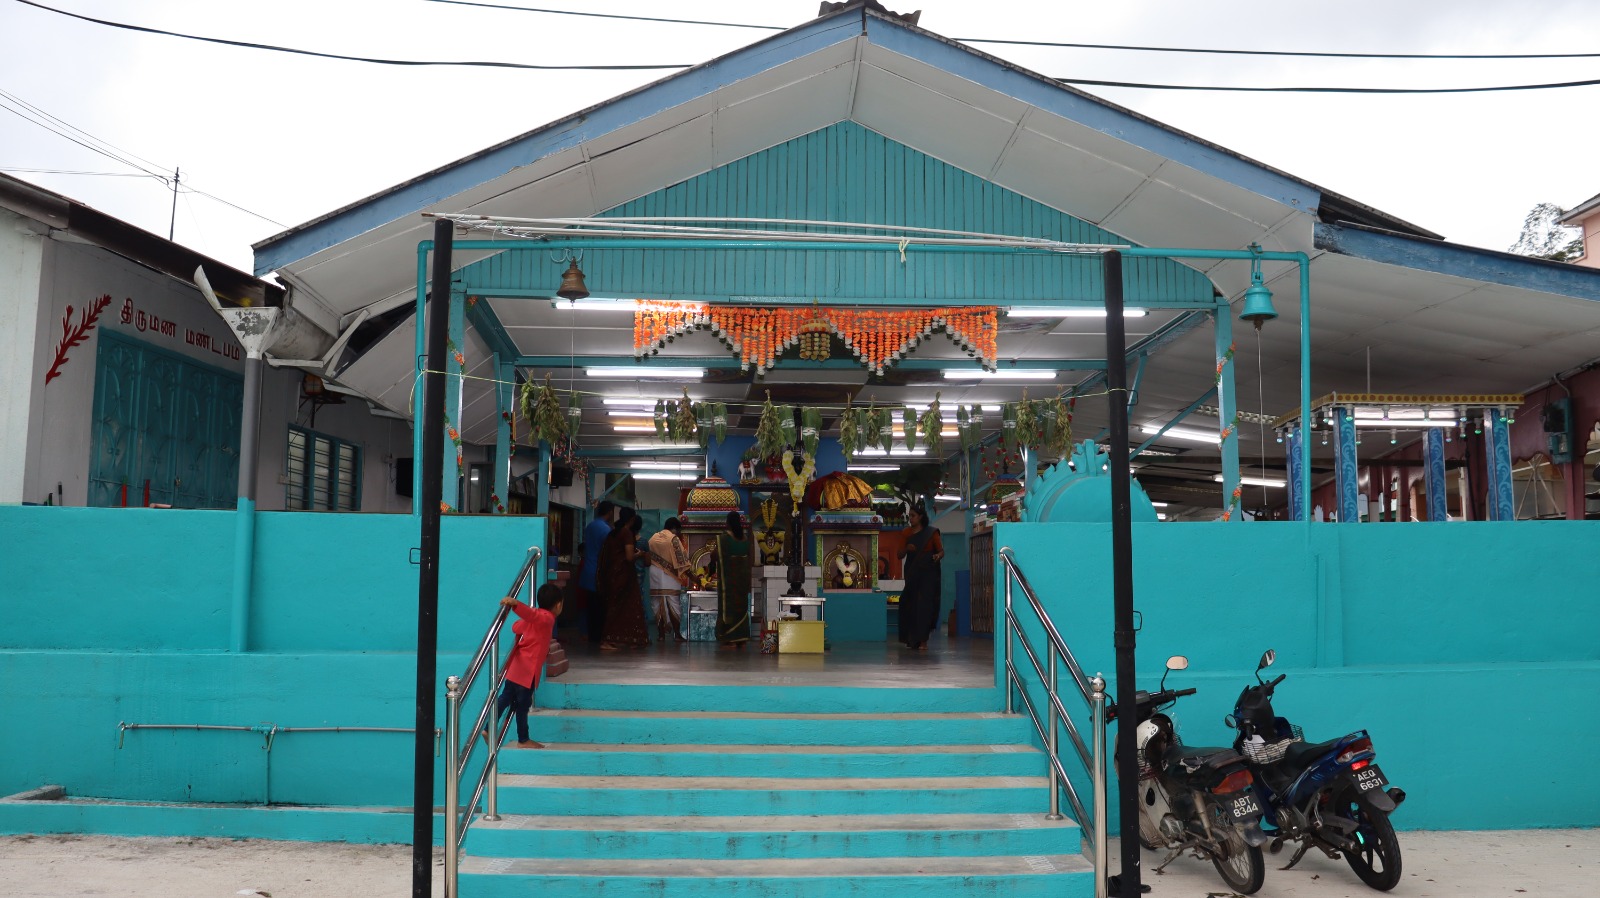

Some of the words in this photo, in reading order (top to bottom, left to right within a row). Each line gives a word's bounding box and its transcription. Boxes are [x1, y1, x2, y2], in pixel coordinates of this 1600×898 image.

[121, 298, 176, 337] திருமண
[186, 328, 239, 360] மண்டபம்
[1358, 770, 1376, 781] AEQ
[1360, 778, 1383, 790] 6631
[1234, 796, 1250, 808] ABT
[1234, 803, 1258, 817] 8344
